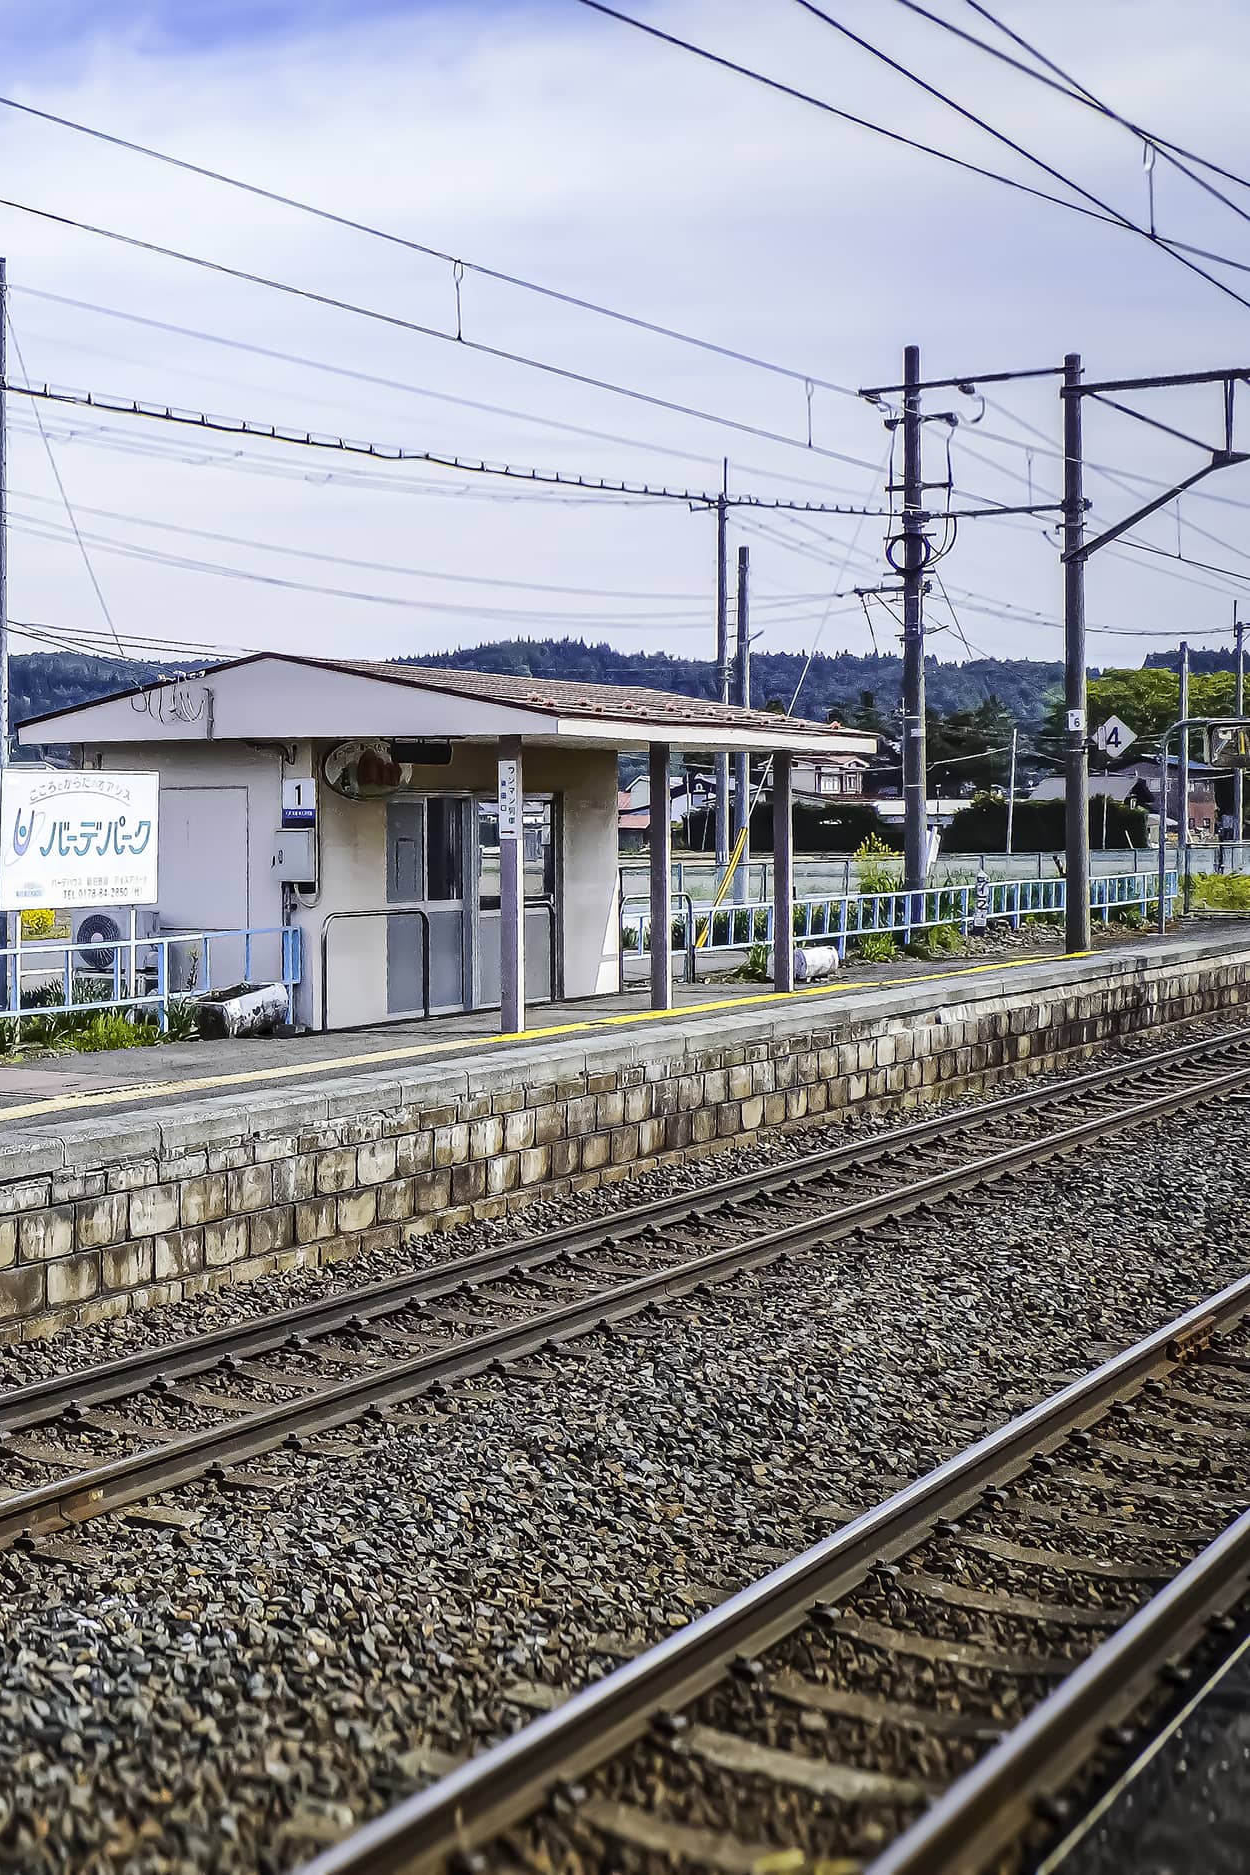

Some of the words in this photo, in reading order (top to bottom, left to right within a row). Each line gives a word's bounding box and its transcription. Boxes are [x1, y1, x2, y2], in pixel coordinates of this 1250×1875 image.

[1073, 717, 1081, 728] 6
[1105, 726, 1122, 748] 4
[294, 783, 302, 806] 1
[39, 815, 152, 857] バーデパーク
